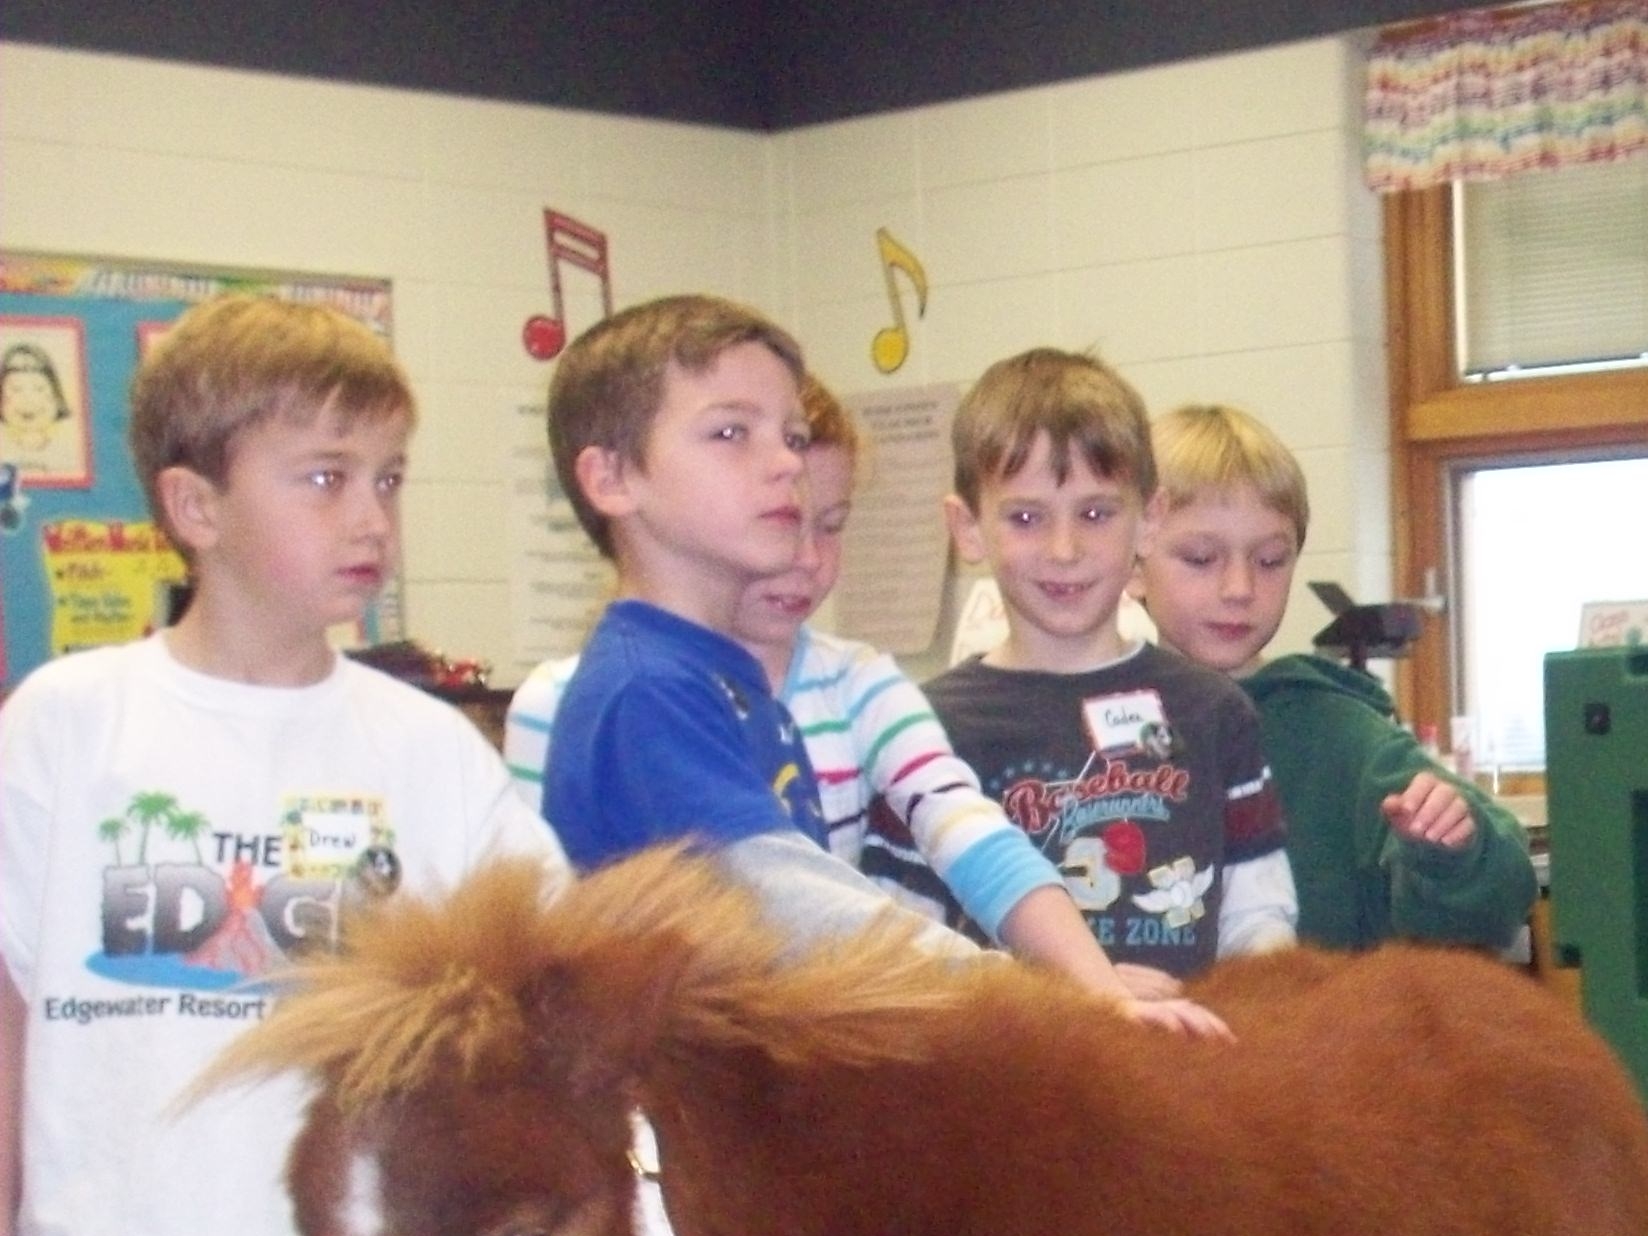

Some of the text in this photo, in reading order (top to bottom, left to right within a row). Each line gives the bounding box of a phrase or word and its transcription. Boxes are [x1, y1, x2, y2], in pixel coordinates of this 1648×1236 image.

[213, 832, 282, 868] THE
[310, 828, 356, 848] Drew
[101, 862, 358, 958] EDG
[1125, 917, 1196, 946] ZONE
[45, 993, 266, 1023] Edgewater Resort
